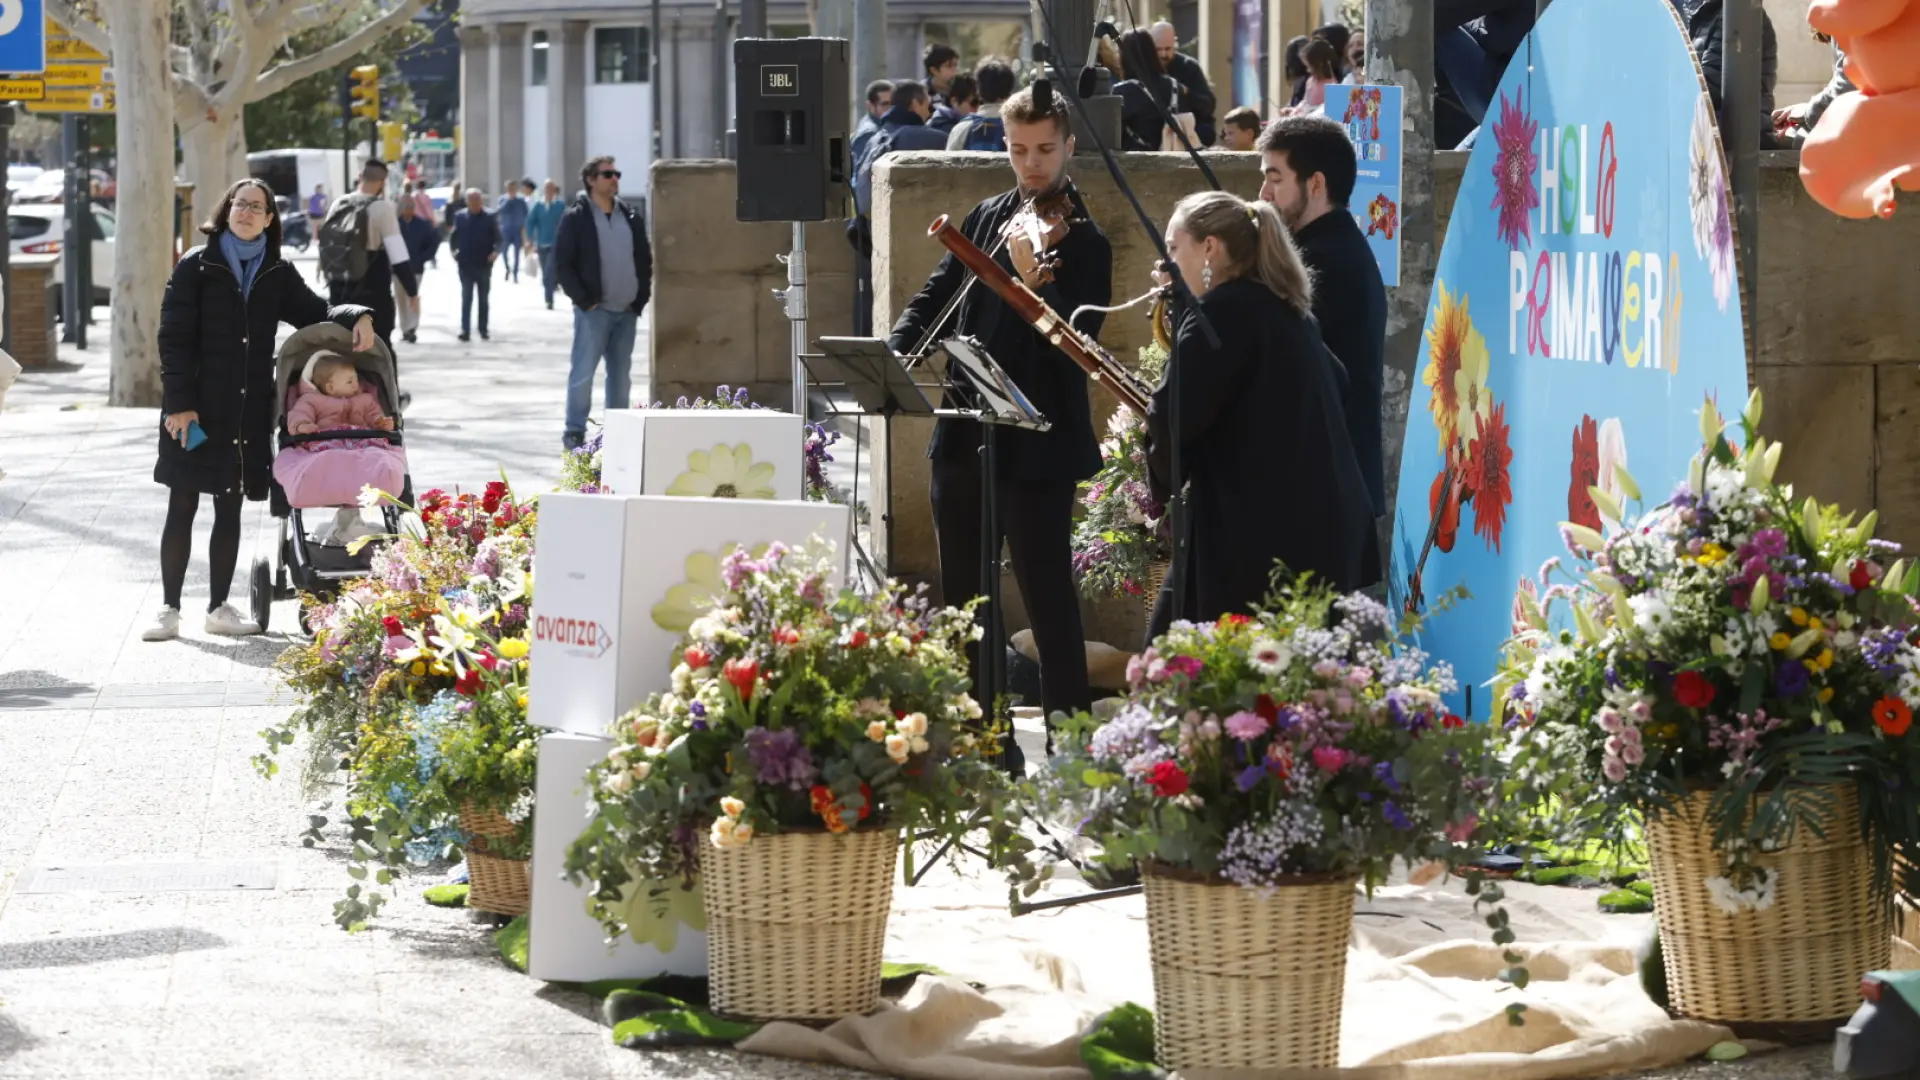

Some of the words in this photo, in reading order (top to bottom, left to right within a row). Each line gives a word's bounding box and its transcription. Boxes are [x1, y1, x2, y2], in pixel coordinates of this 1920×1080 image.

[769, 73, 793, 87] JBL
[1541, 120, 1617, 240] HOLA
[1509, 250, 1683, 375] PRIMAVERA
[536, 615, 597, 647] avanza
